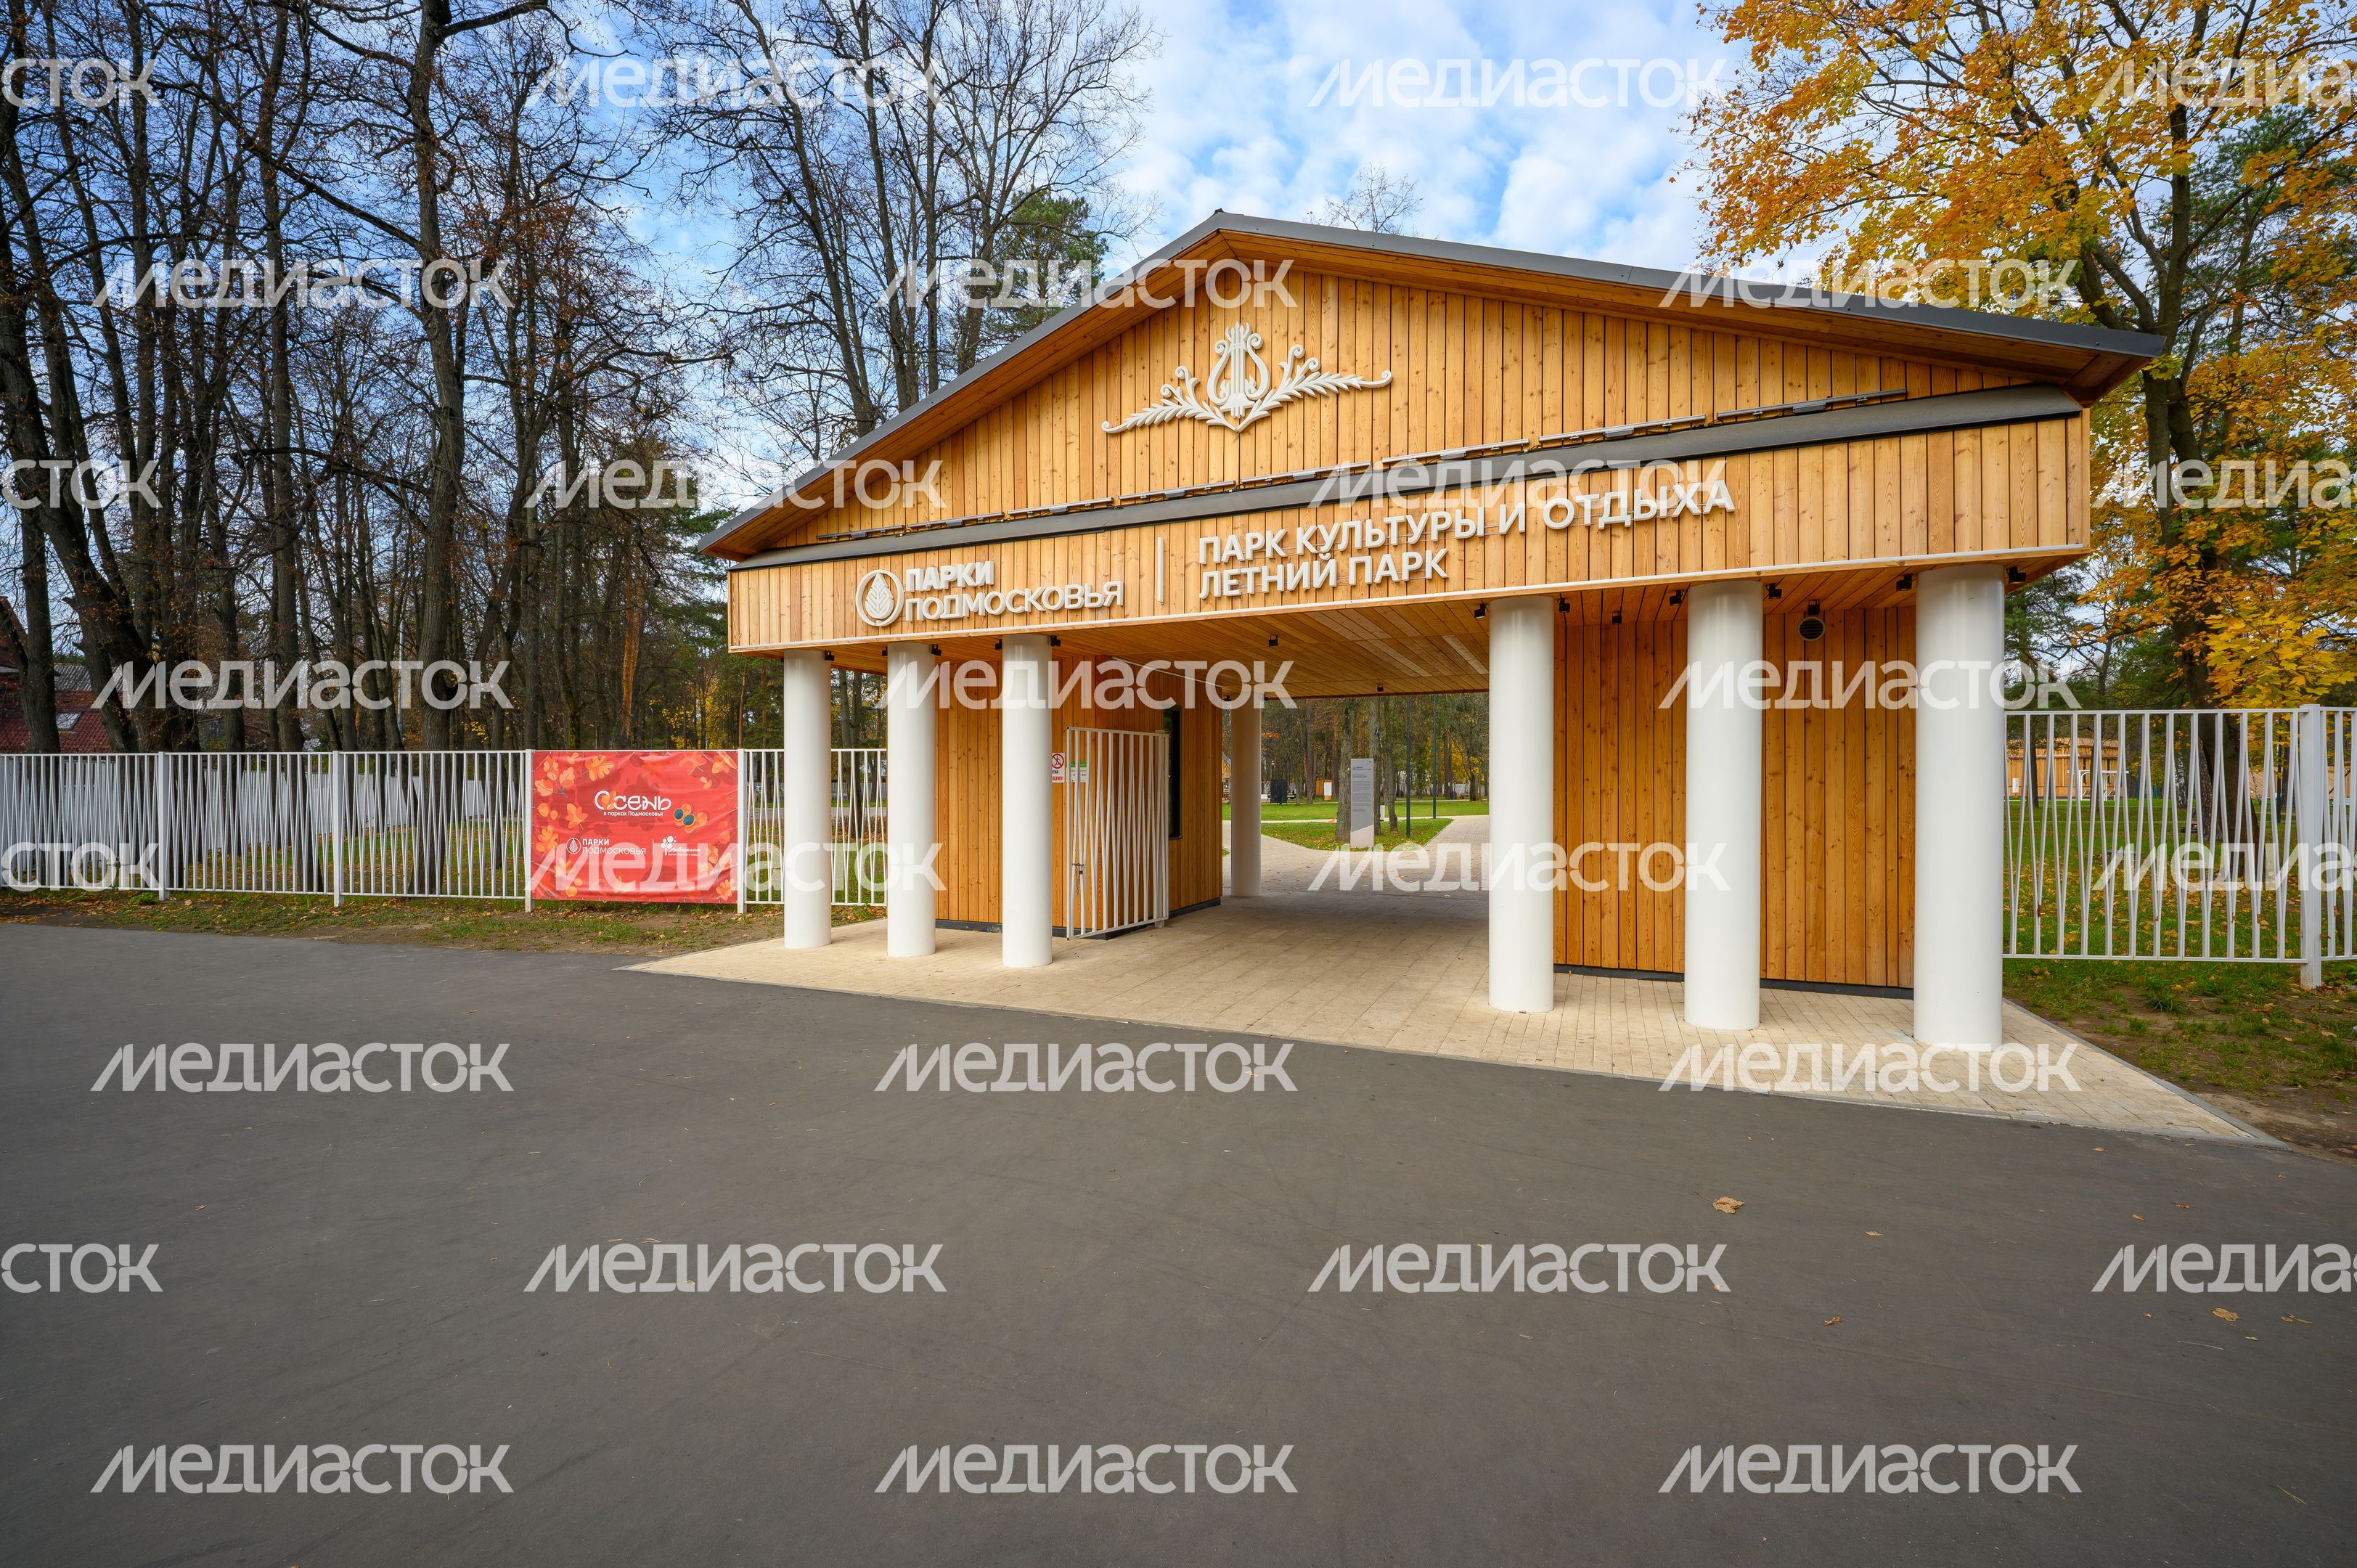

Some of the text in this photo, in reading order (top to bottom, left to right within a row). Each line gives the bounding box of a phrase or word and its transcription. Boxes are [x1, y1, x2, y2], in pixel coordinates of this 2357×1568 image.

[1199, 479, 1736, 565] ПАРК КУЛЬТУРЫ И ОТДЫХА
[905, 560, 994, 593] ПАРКИ
[1198, 547, 1449, 600] ЛЕТНИЙ ПАРК
[905, 580, 1125, 623] ПОДМОСКОВЬЯ
[595, 790, 671, 811] Осень
[582, 846, 646, 855] ПОДМОСКОВЬЯ
